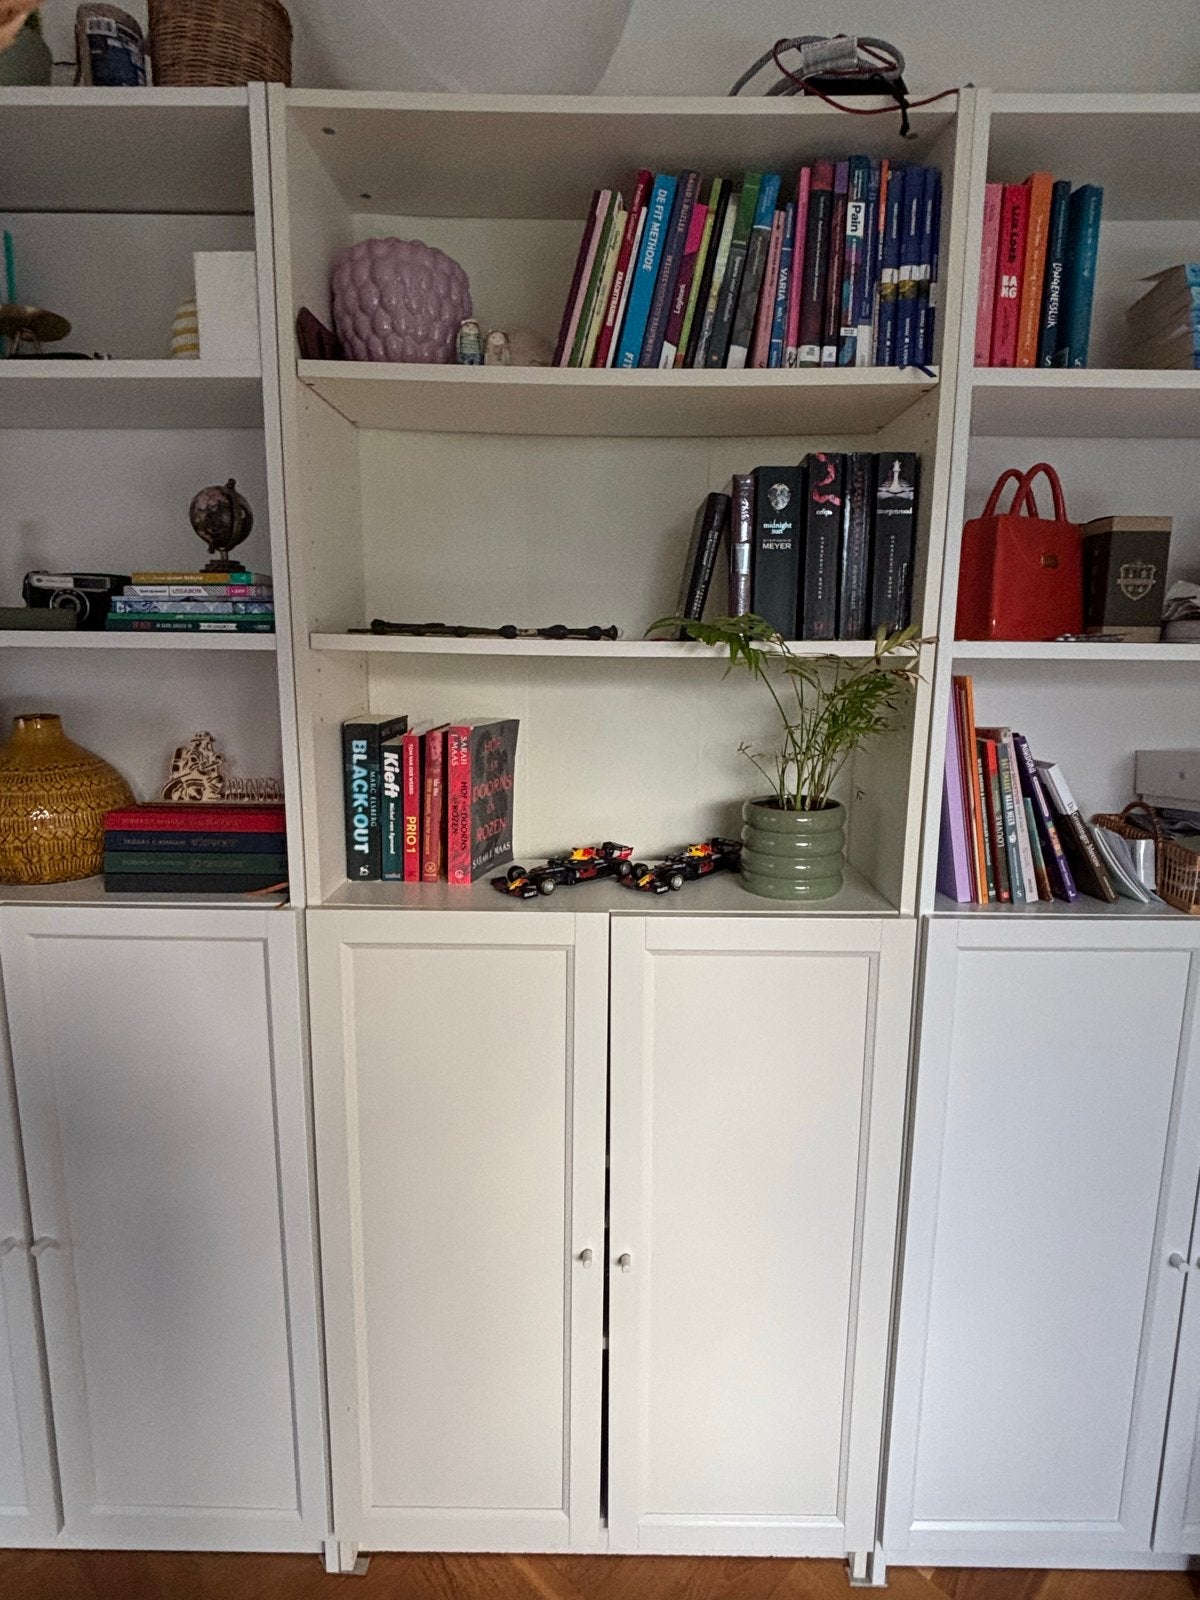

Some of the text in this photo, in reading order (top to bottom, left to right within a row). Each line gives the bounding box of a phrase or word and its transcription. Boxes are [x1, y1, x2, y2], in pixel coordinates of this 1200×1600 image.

[643, 189, 667, 272] DE FIT METHODE
[850, 205, 861, 232] Pain
[777, 267, 788, 300] VARIA
[763, 519, 792, 529] midnight
[450, 741, 458, 766] MAAS
[383, 751, 400, 798] Kieft
[352, 740, 368, 853] BLACK-OUT
[406, 816, 416, 845] PRIO
[994, 815, 1004, 847] LOUVRE
[1072, 812, 1090, 846] Groninger
